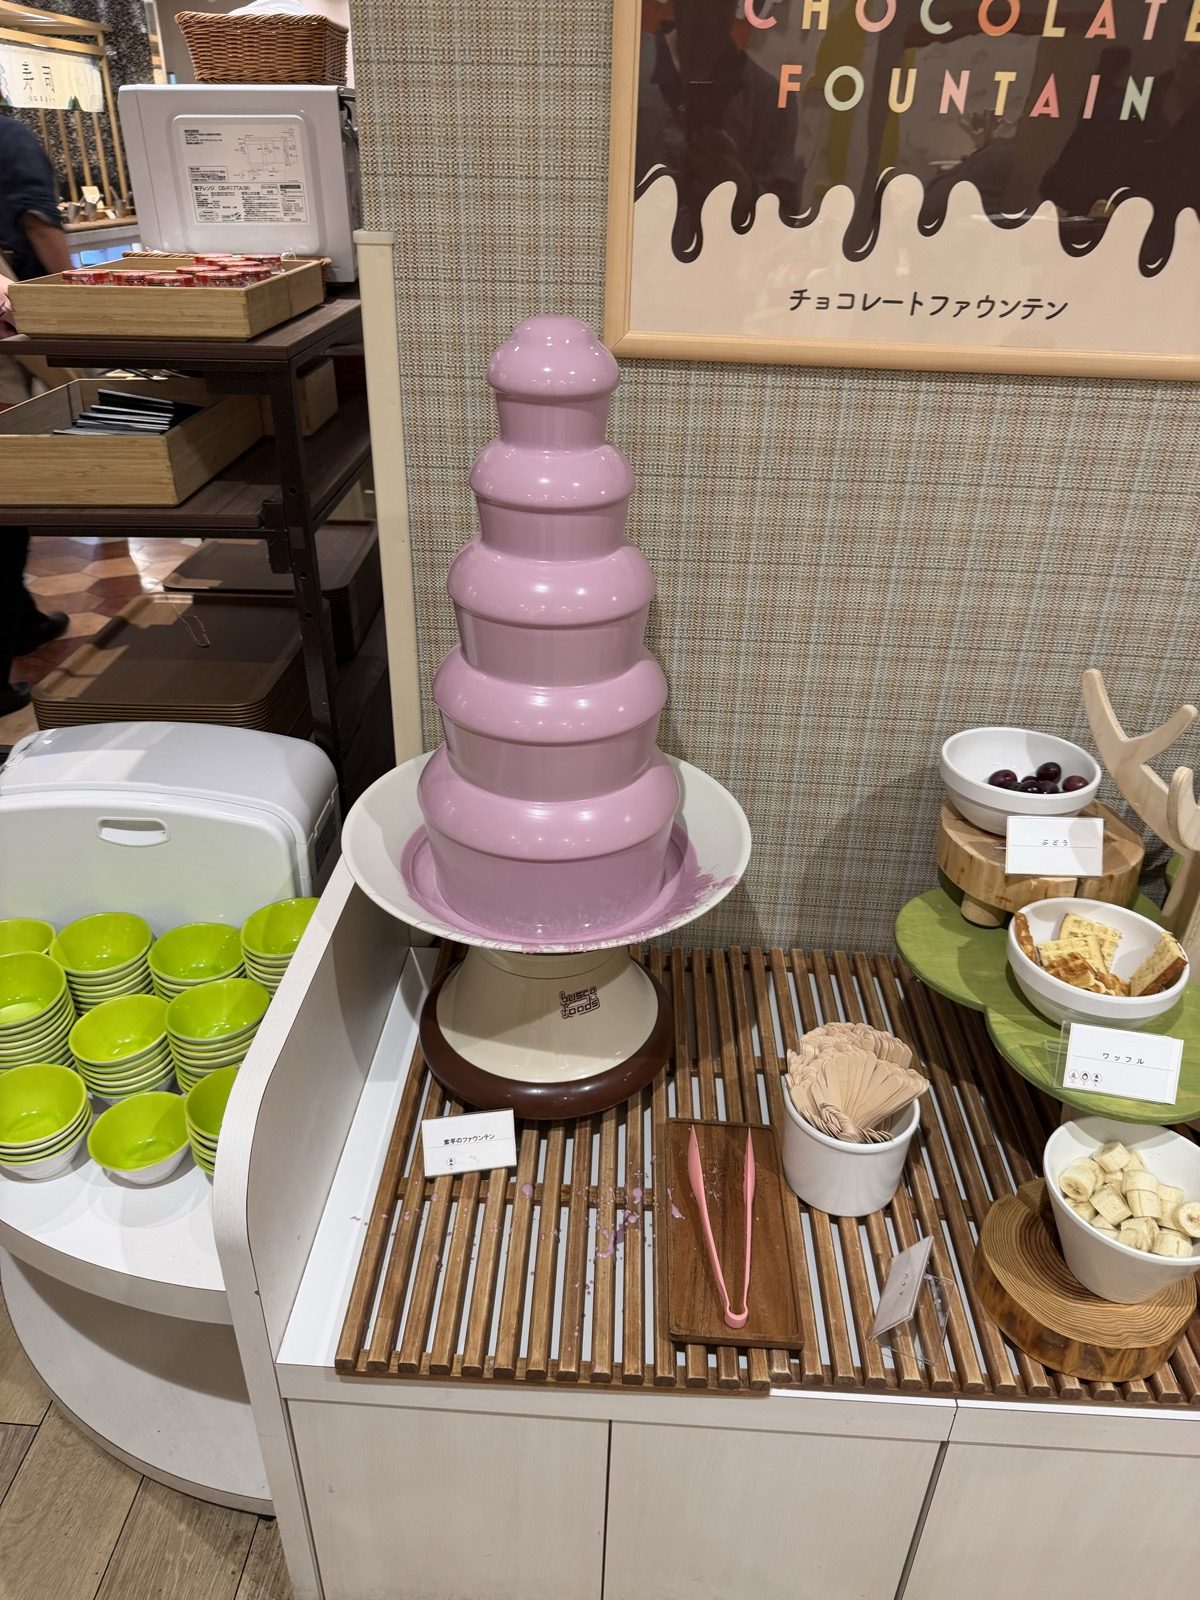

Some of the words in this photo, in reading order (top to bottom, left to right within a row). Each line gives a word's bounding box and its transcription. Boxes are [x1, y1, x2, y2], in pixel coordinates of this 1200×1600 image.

[777, 64, 1155, 121] FOUNTAIN
[789, 288, 1069, 321] チョコレートファウンテン
[1041, 839, 1068, 847] ぶどう
[561, 996, 599, 1018] foods
[1102, 1052, 1145, 1065] ワッフル
